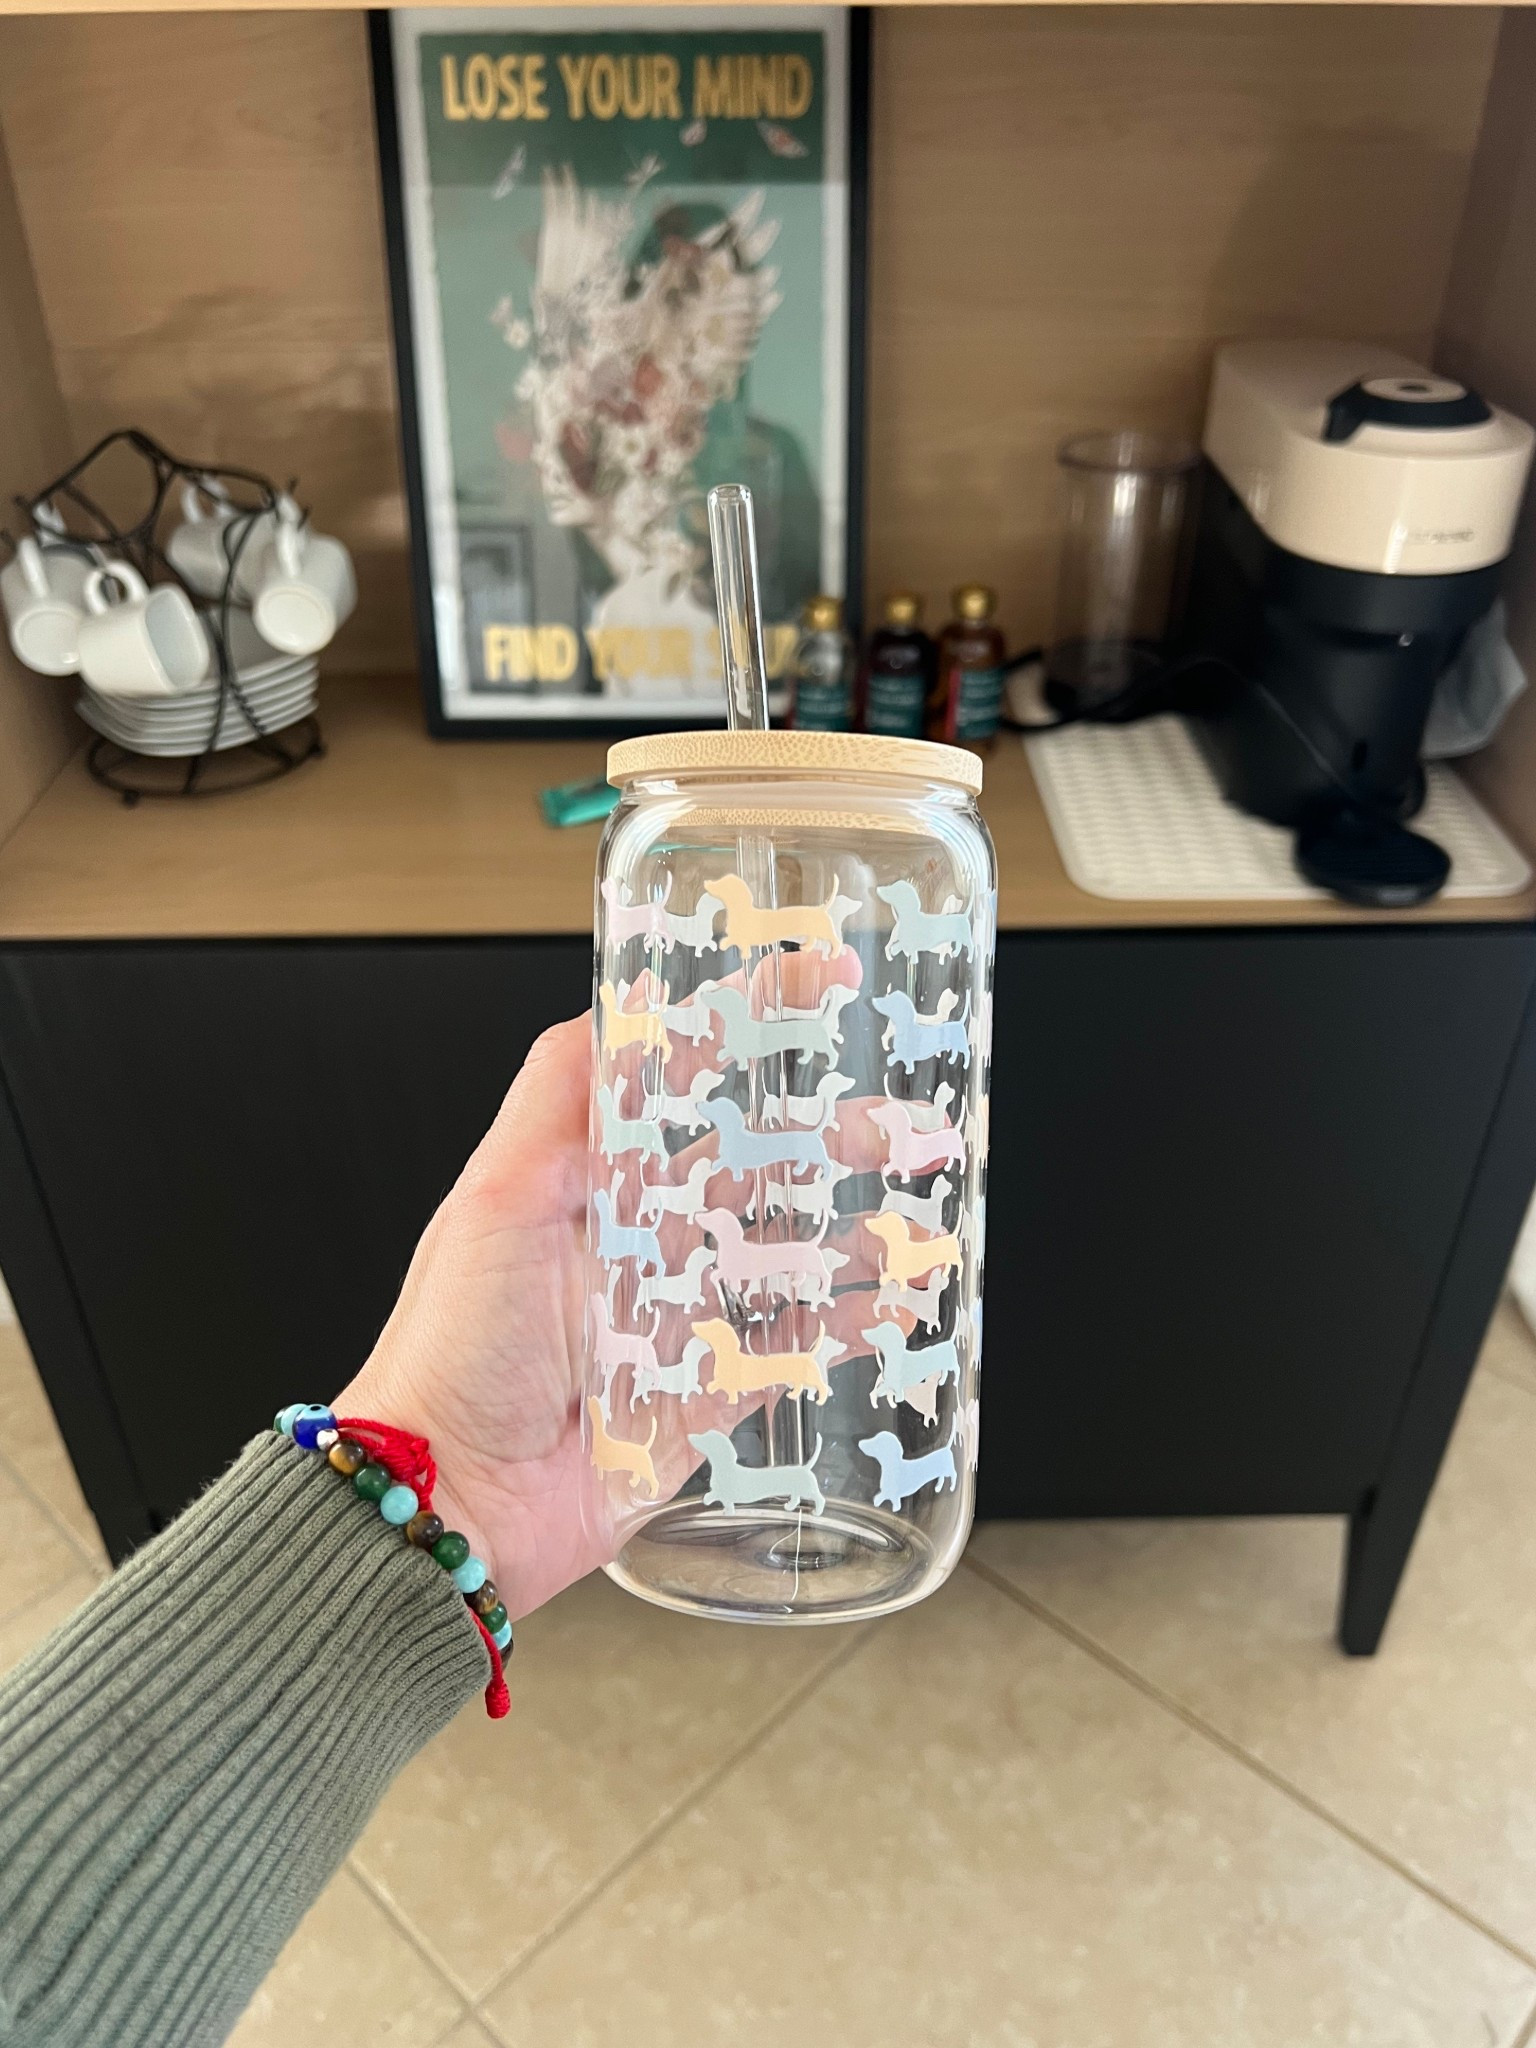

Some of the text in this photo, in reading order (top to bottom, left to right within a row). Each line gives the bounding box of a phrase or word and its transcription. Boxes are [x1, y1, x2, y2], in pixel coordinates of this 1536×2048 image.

[441, 53, 812, 121] LOSE YOUR MIND
[484, 624, 578, 682] FIND
